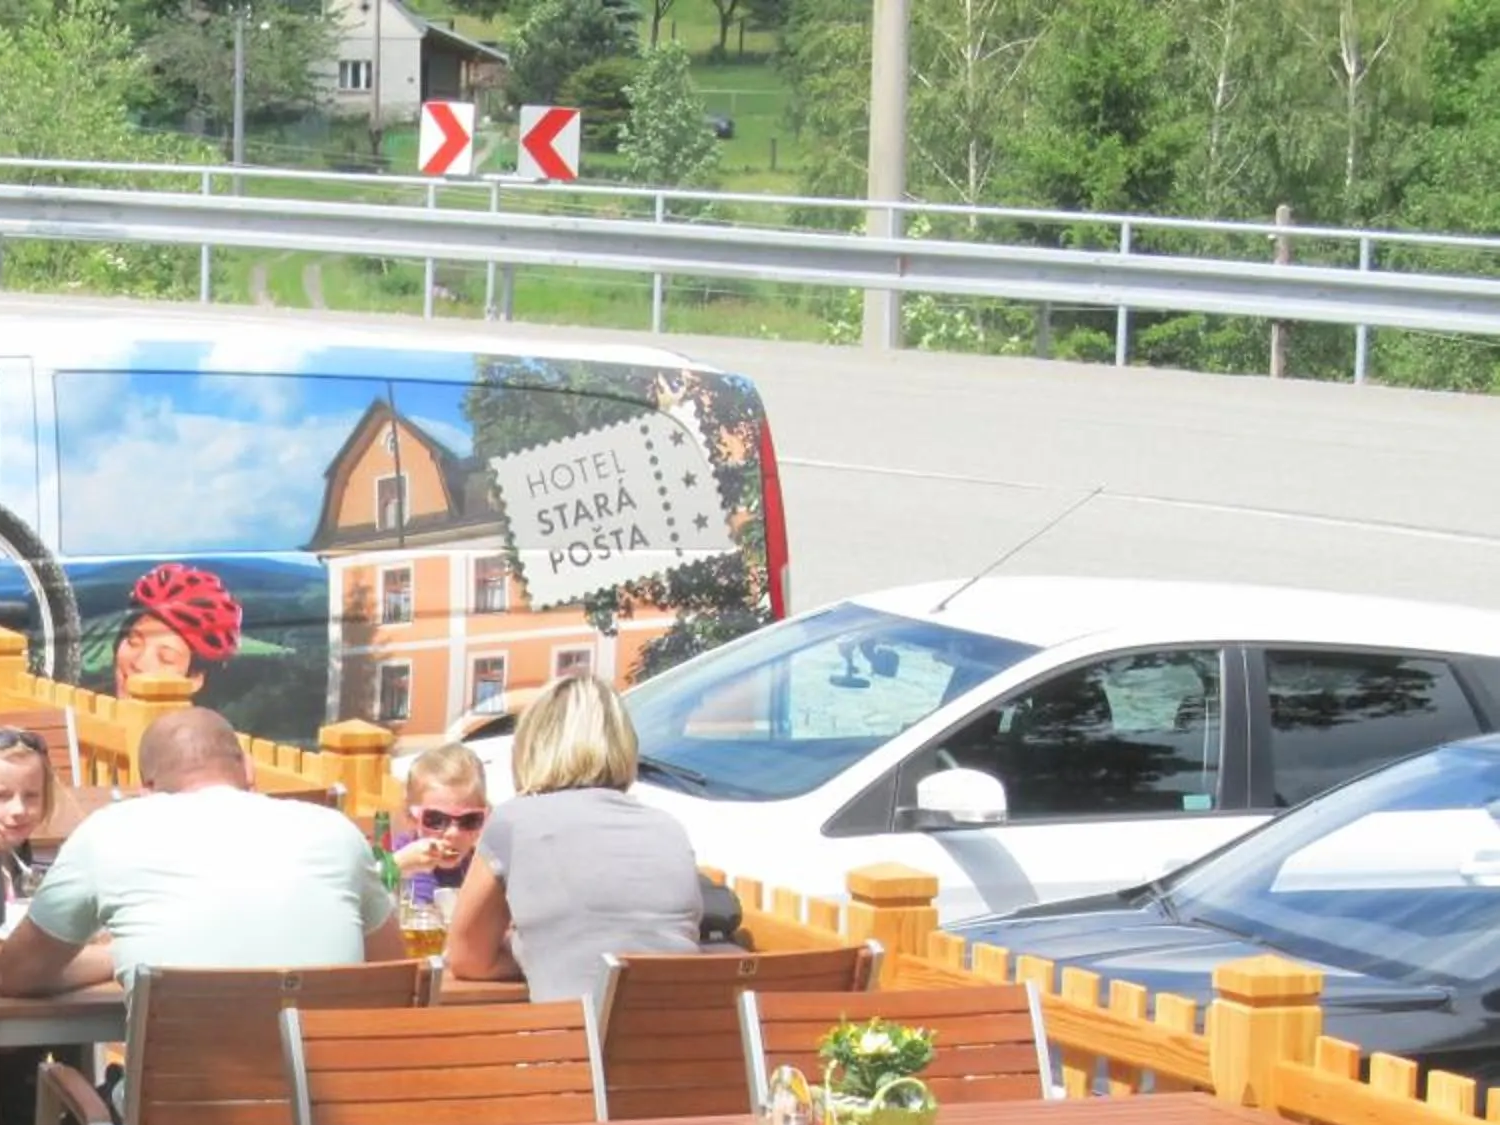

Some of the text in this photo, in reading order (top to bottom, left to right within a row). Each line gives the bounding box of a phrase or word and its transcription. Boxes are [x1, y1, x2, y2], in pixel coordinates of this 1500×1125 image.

[526, 450, 626, 498] HOTEL
[537, 477, 637, 536] STARÁ
[549, 523, 650, 574] POŠTA
